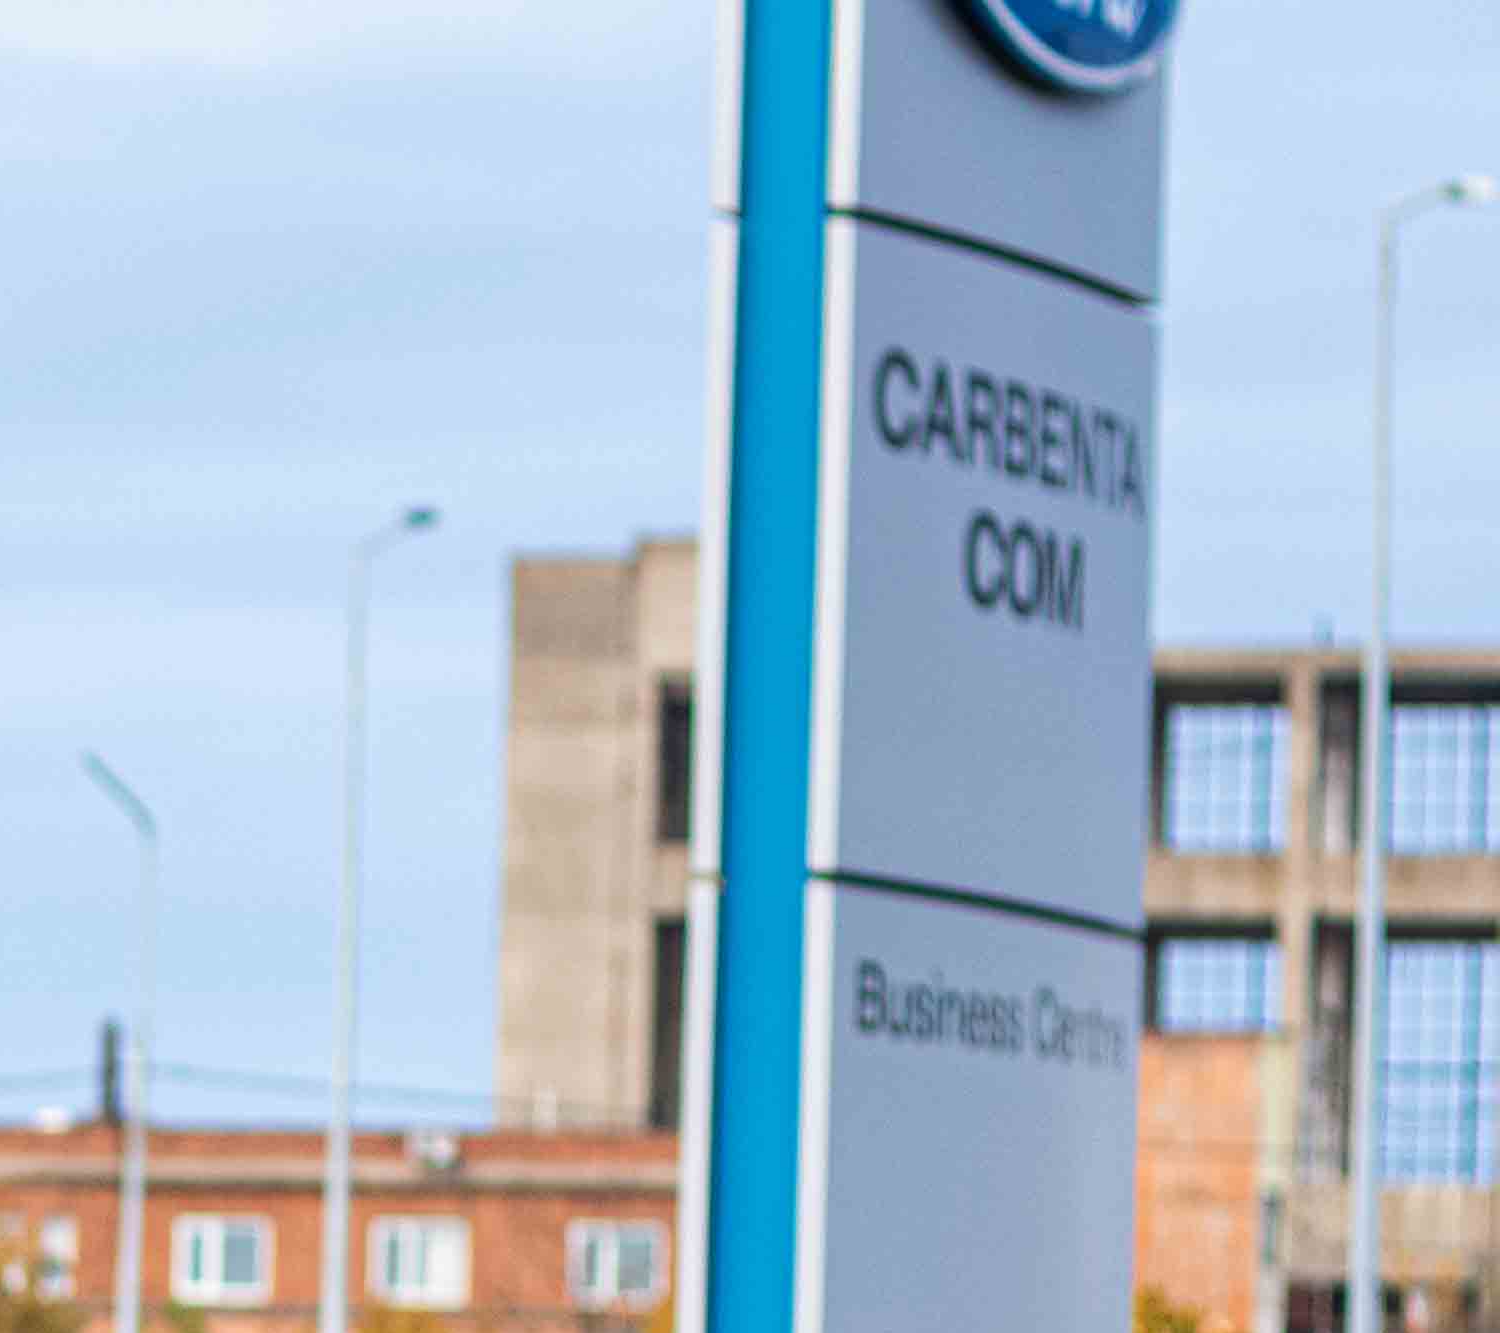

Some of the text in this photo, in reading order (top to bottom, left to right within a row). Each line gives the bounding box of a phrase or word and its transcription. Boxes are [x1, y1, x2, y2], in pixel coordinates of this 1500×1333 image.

[871, 346, 1145, 523] CARBENTA
[962, 507, 1084, 631] COM
[854, 956, 1024, 1058] Business
